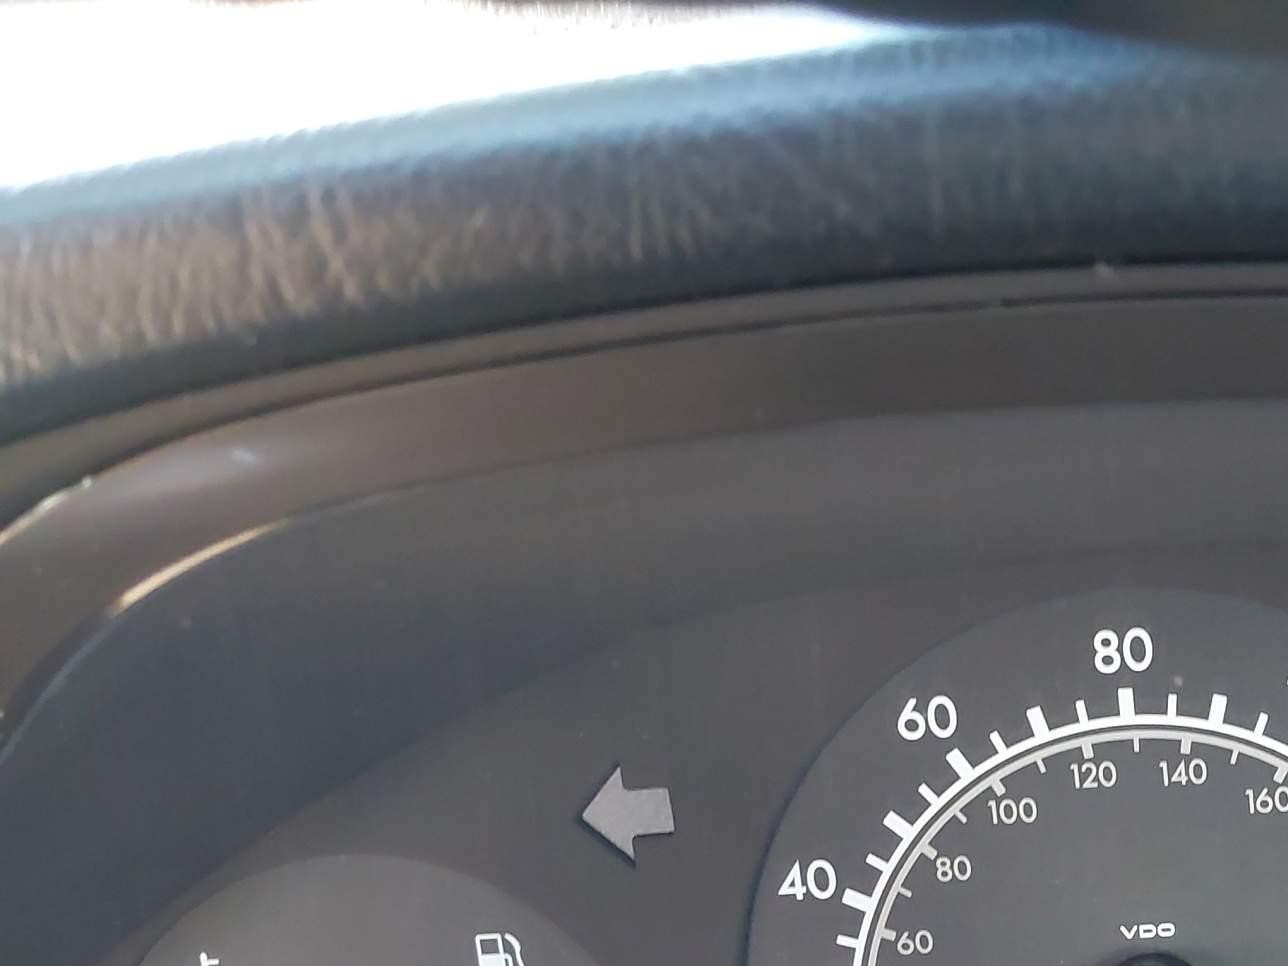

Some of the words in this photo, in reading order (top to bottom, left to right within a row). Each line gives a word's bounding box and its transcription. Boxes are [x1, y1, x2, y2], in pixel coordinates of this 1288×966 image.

[1093, 627, 1153, 674] 80
[897, 696, 958, 741] 60
[1070, 761, 1117, 789] 120
[1159, 759, 1207, 785] 140
[987, 797, 1037, 824] 100
[778, 859, 837, 900] 40
[935, 856, 972, 882] 80
[896, 930, 934, 955] 60
[1120, 923, 1176, 939] VDO
